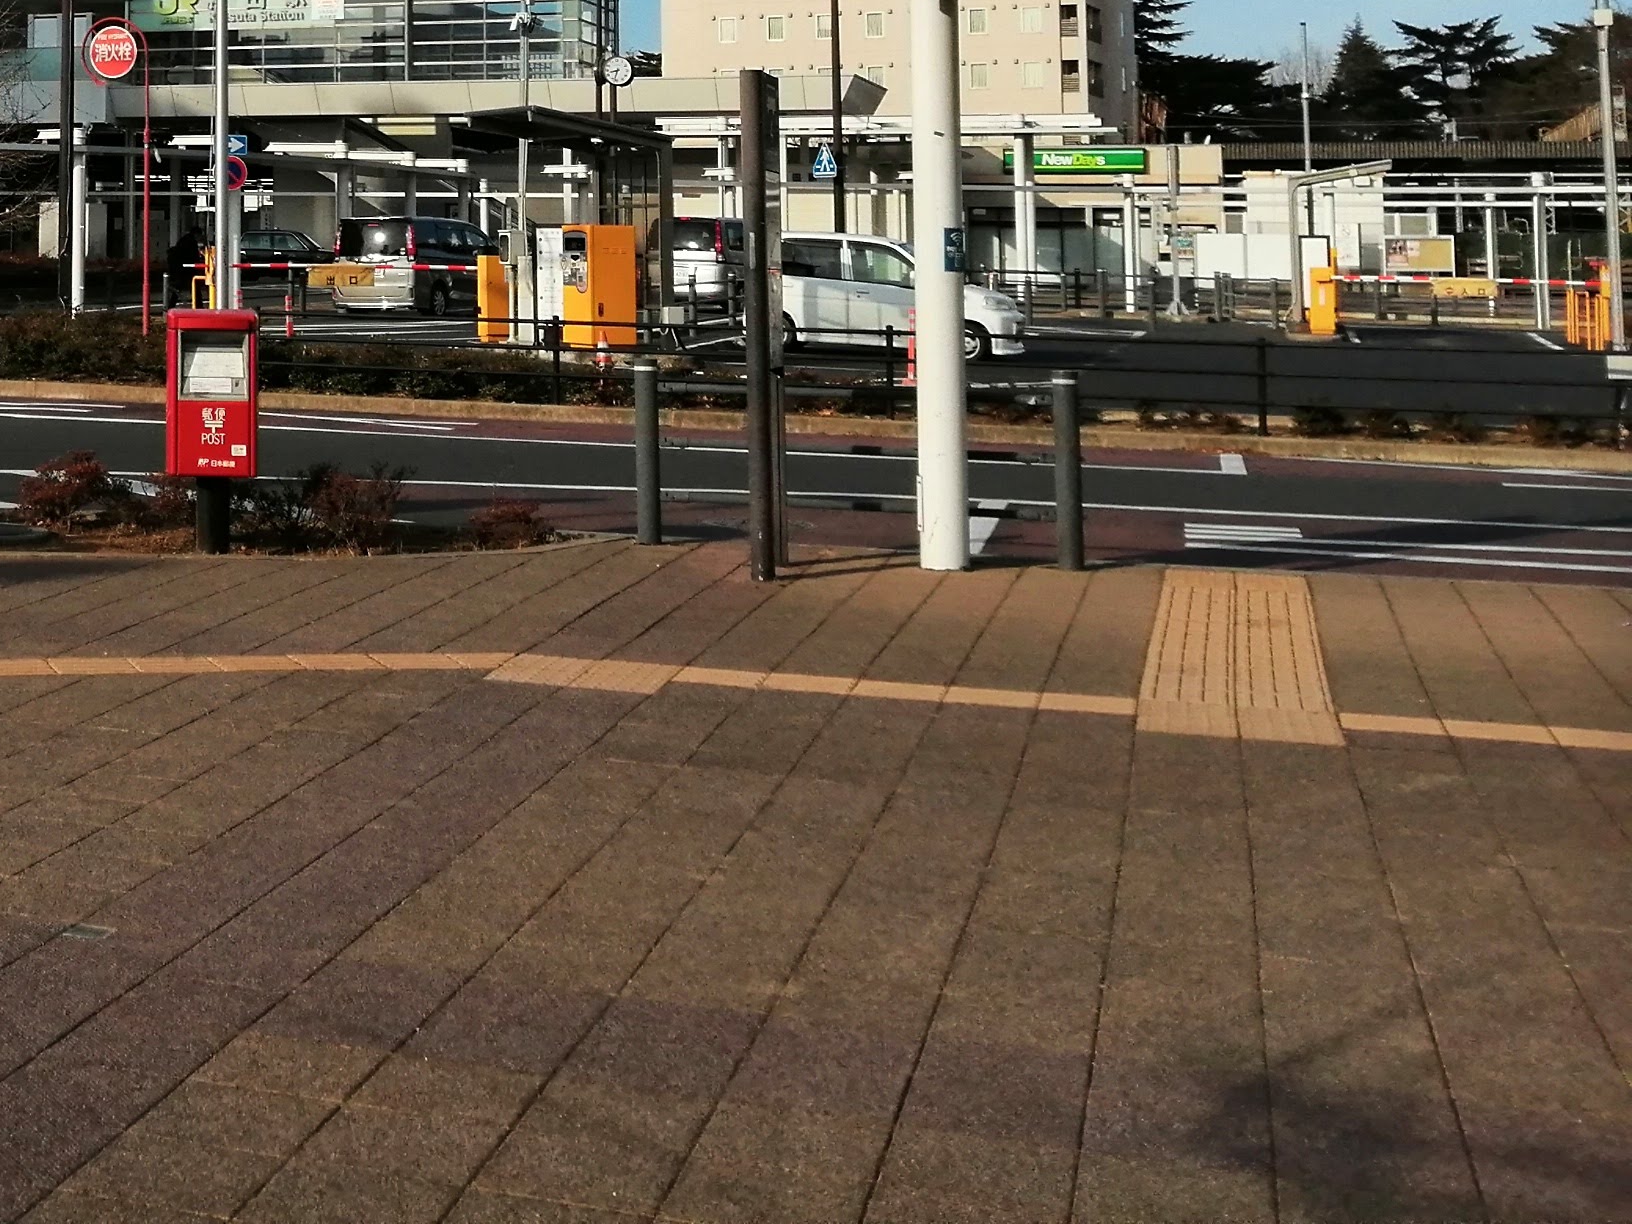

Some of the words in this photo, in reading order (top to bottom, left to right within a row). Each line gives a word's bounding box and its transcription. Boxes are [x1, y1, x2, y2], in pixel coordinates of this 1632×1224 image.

[260, 9, 306, 23] Station
[94, 41, 133, 63] 消火栓
[1041, 152, 1106, 167] NewDays
[326, 276, 358, 285] 出口
[201, 407, 226, 421] 郵便
[201, 432, 226, 445] POST
